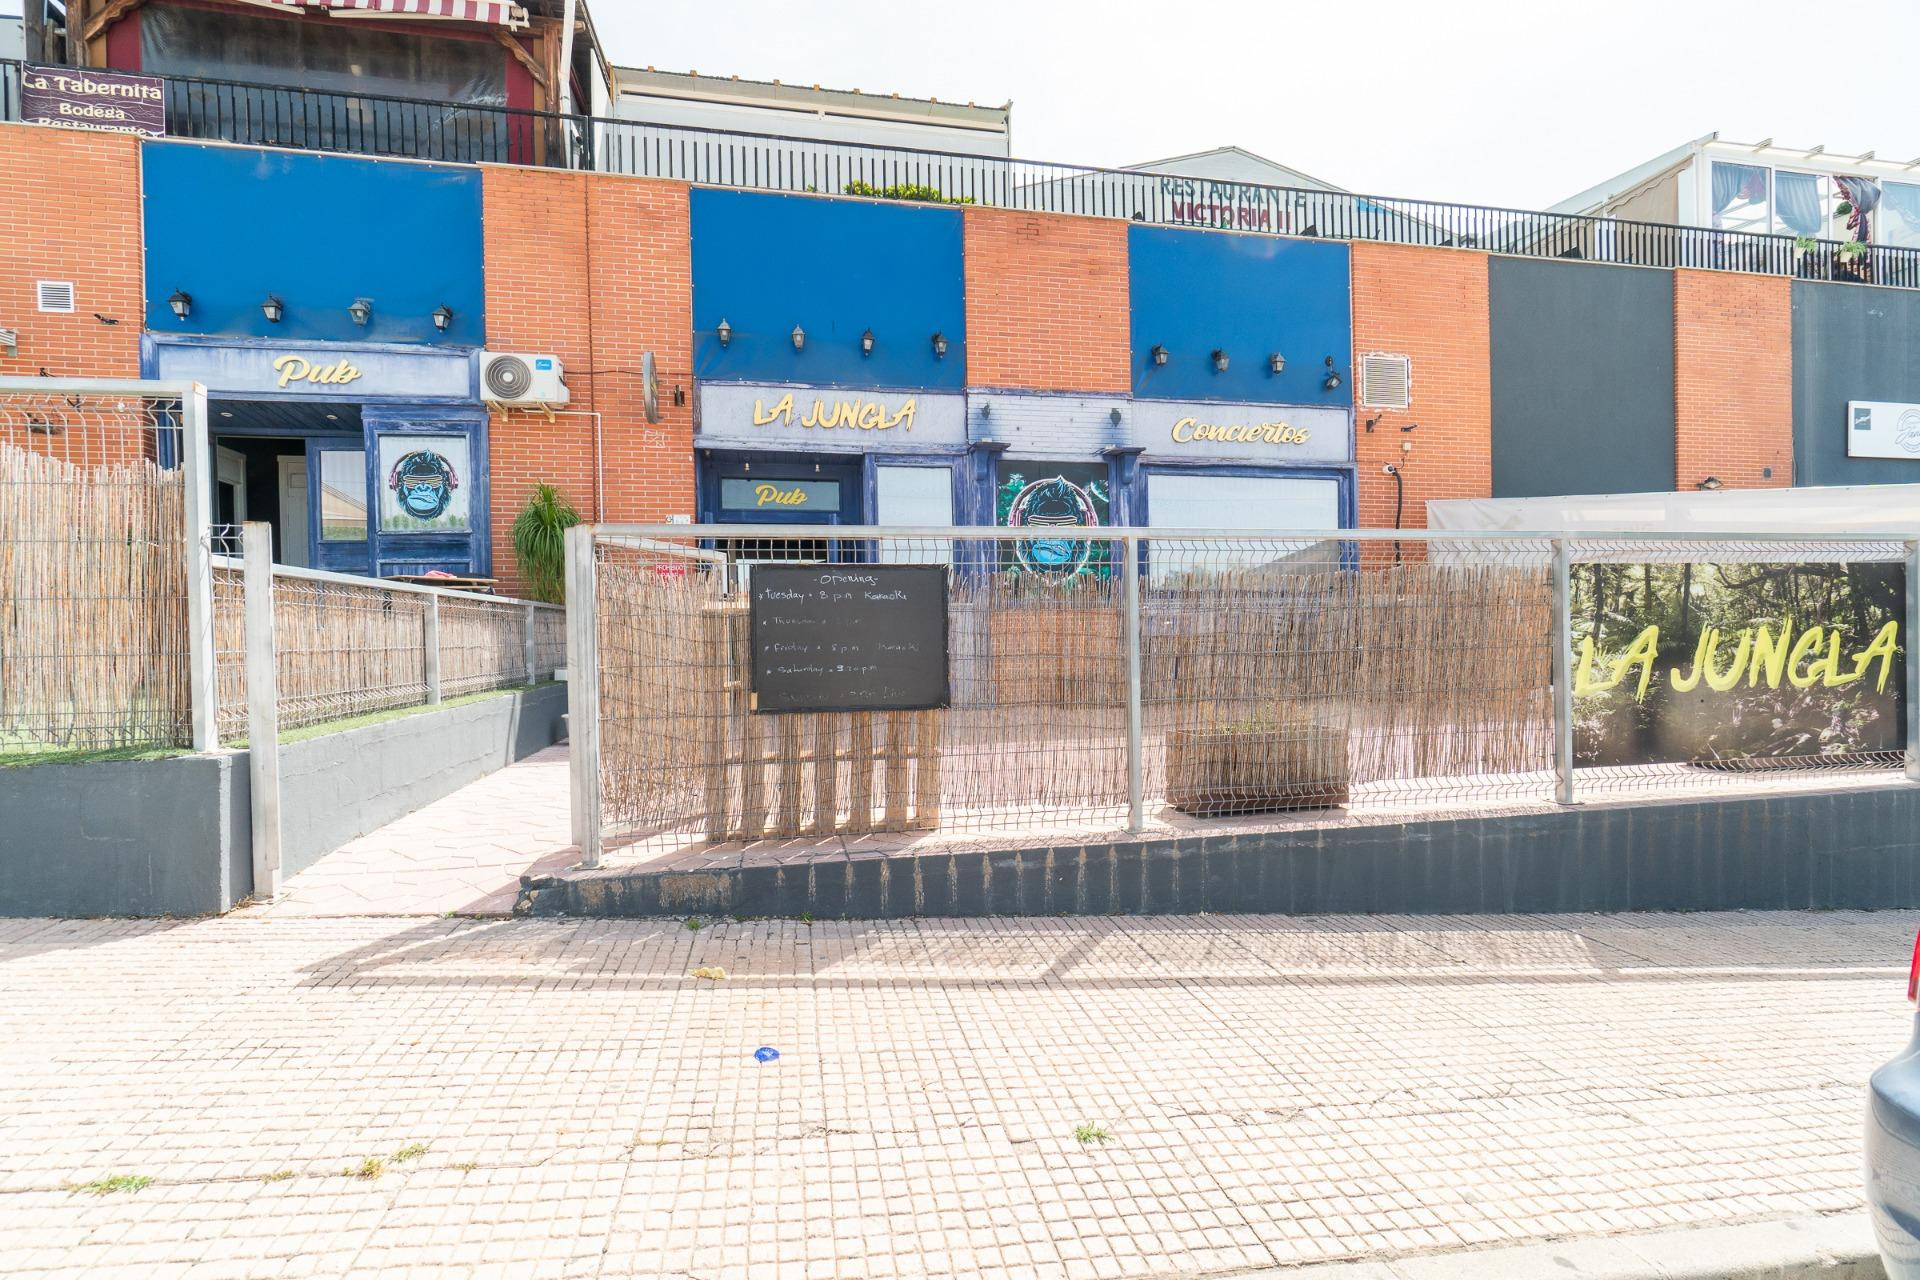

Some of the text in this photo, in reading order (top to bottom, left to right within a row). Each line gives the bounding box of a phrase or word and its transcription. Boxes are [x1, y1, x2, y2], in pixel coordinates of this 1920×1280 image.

[23, 71, 162, 100] La Tabernita
[59, 102, 126, 119] Bodega
[273, 354, 362, 388] Pub
[753, 393, 917, 432] LA JUNGLA
[1172, 416, 1312, 445] Conciertos
[755, 484, 808, 507] Pub
[1574, 613, 1899, 704] LA JUNGLA
